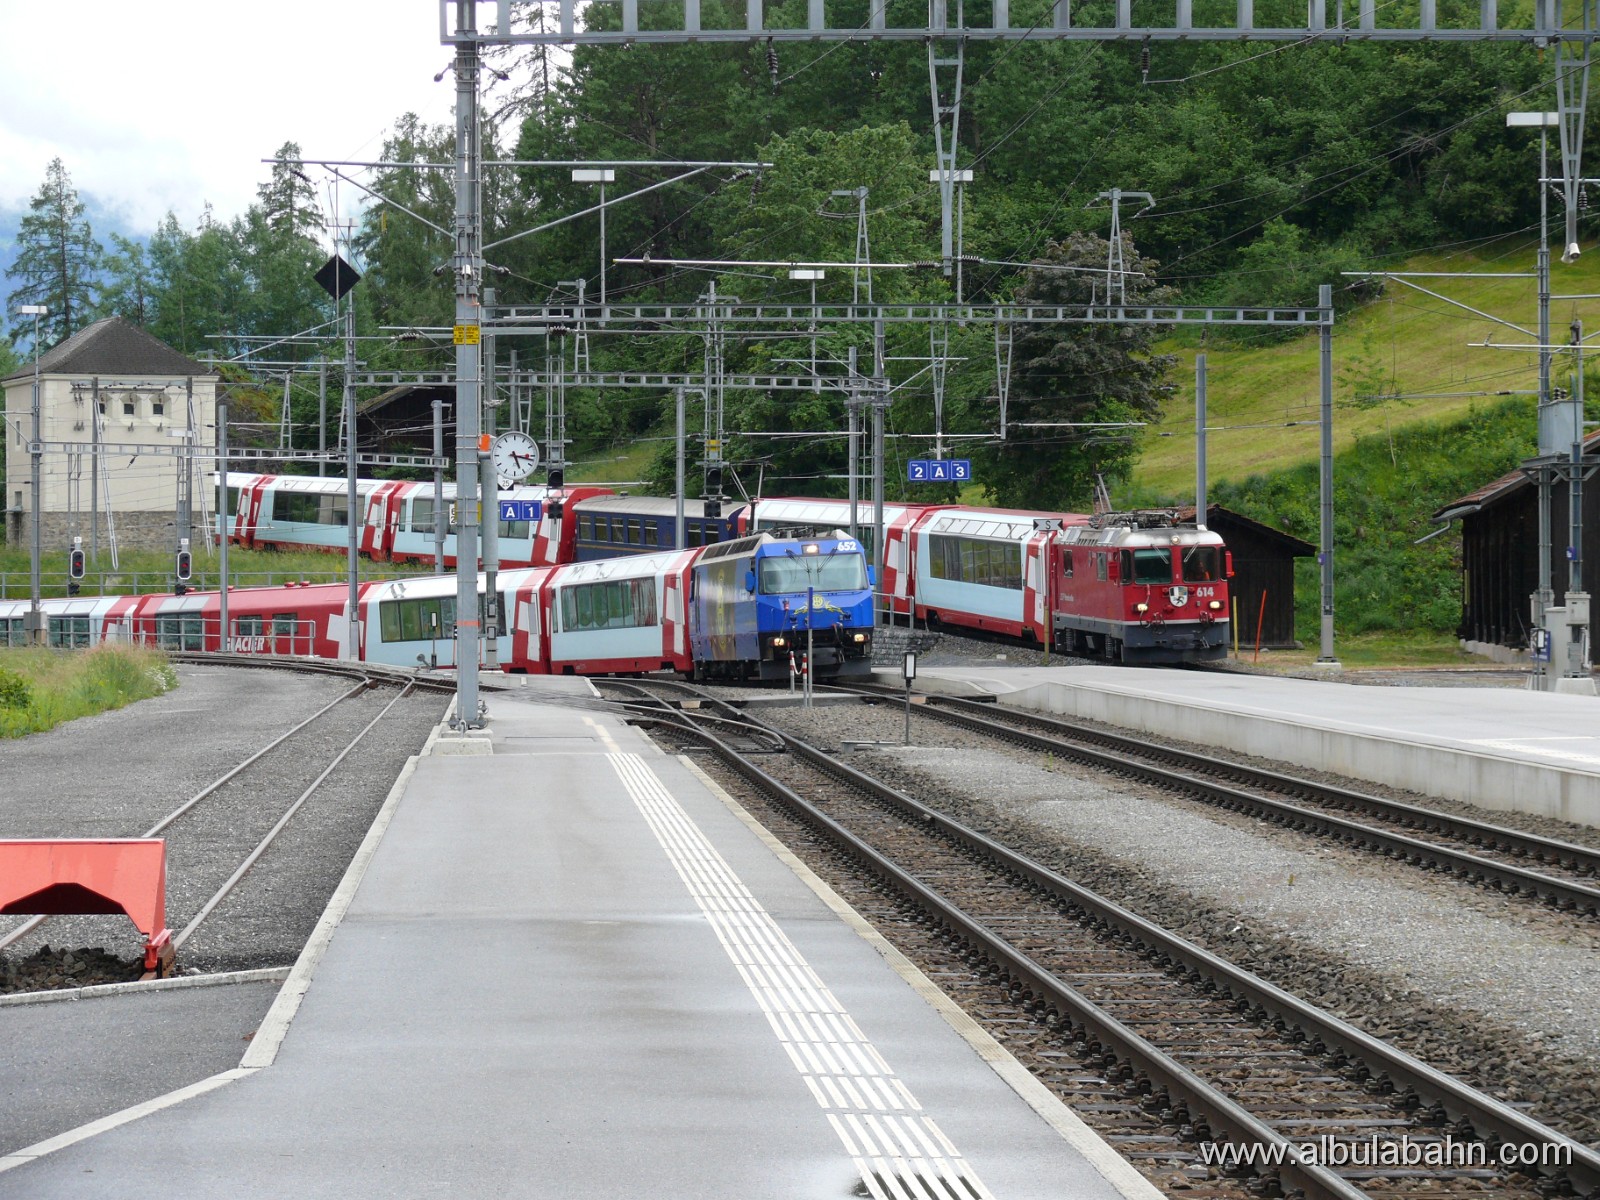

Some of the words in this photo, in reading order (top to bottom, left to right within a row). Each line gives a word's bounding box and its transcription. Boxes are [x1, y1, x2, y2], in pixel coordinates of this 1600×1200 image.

[914, 467, 923, 478] 2
[934, 467, 944, 478] A
[956, 466, 965, 478] 3
[502, 479, 510, 487] 25
[505, 506, 515, 518] A
[528, 506, 534, 518] 1
[1045, 520, 1051, 530] S
[837, 541, 857, 551] 652
[1196, 586, 1214, 597] 614
